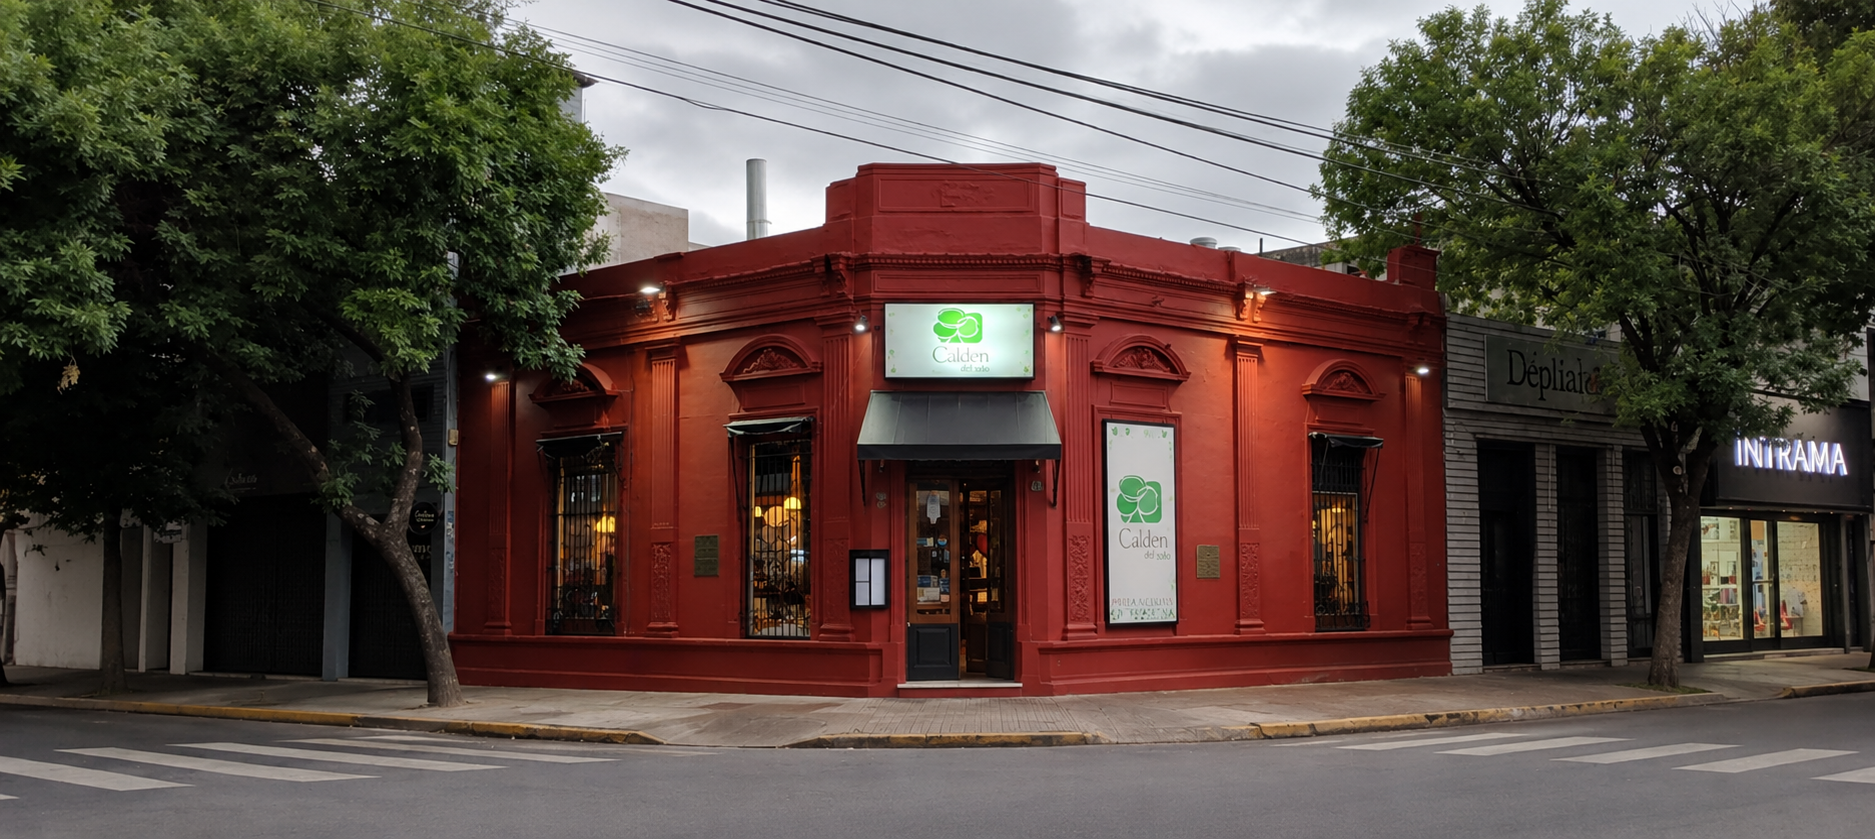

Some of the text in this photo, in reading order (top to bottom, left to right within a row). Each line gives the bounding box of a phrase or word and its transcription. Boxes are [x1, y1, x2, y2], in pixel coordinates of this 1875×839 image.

[932, 346, 989, 363] Calden
[1507, 349, 1602, 401] Déplia
[1734, 436, 1848, 476] INTRAMA
[1118, 527, 1168, 549] Calden
